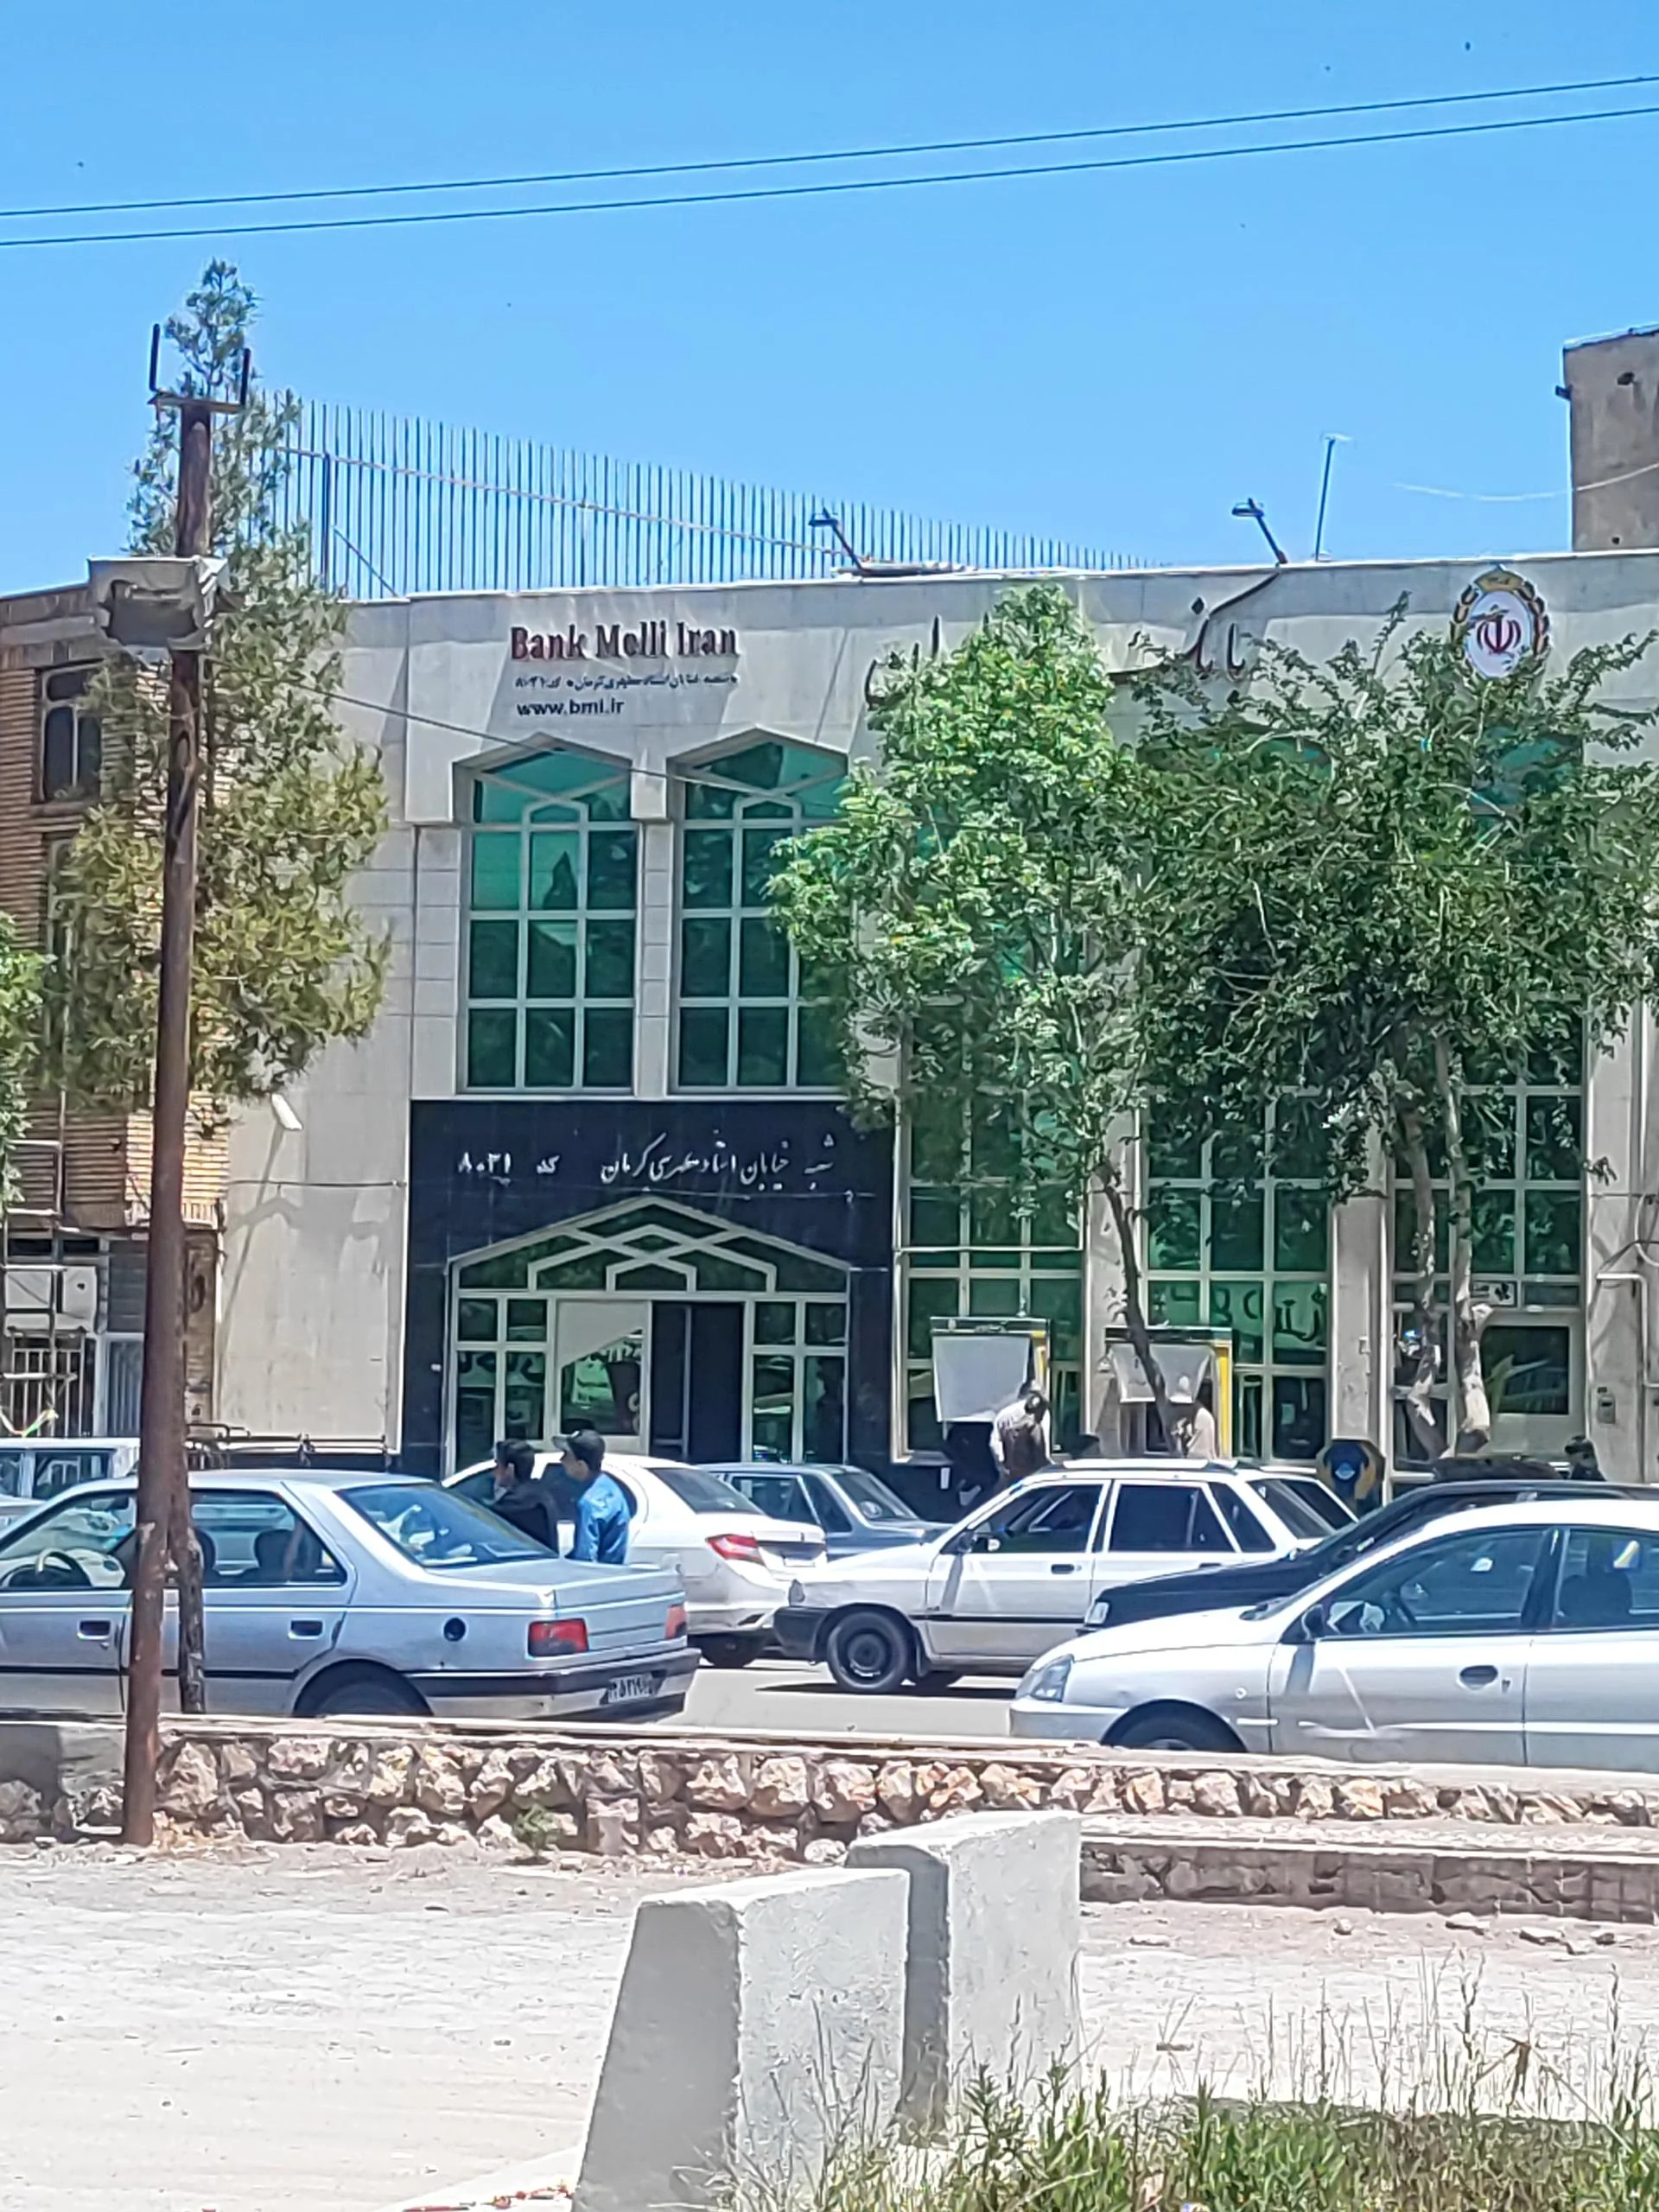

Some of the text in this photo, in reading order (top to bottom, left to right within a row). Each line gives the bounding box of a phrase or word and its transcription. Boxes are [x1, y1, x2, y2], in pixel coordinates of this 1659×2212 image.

[511, 620, 741, 660] Bank Melli Iran
[517, 697, 625, 715] www.bmi.ir
[536, 1154, 560, 1174] کد
[601, 1132, 666, 1184] کرمان
[740, 1140, 790, 1192] خیابان
